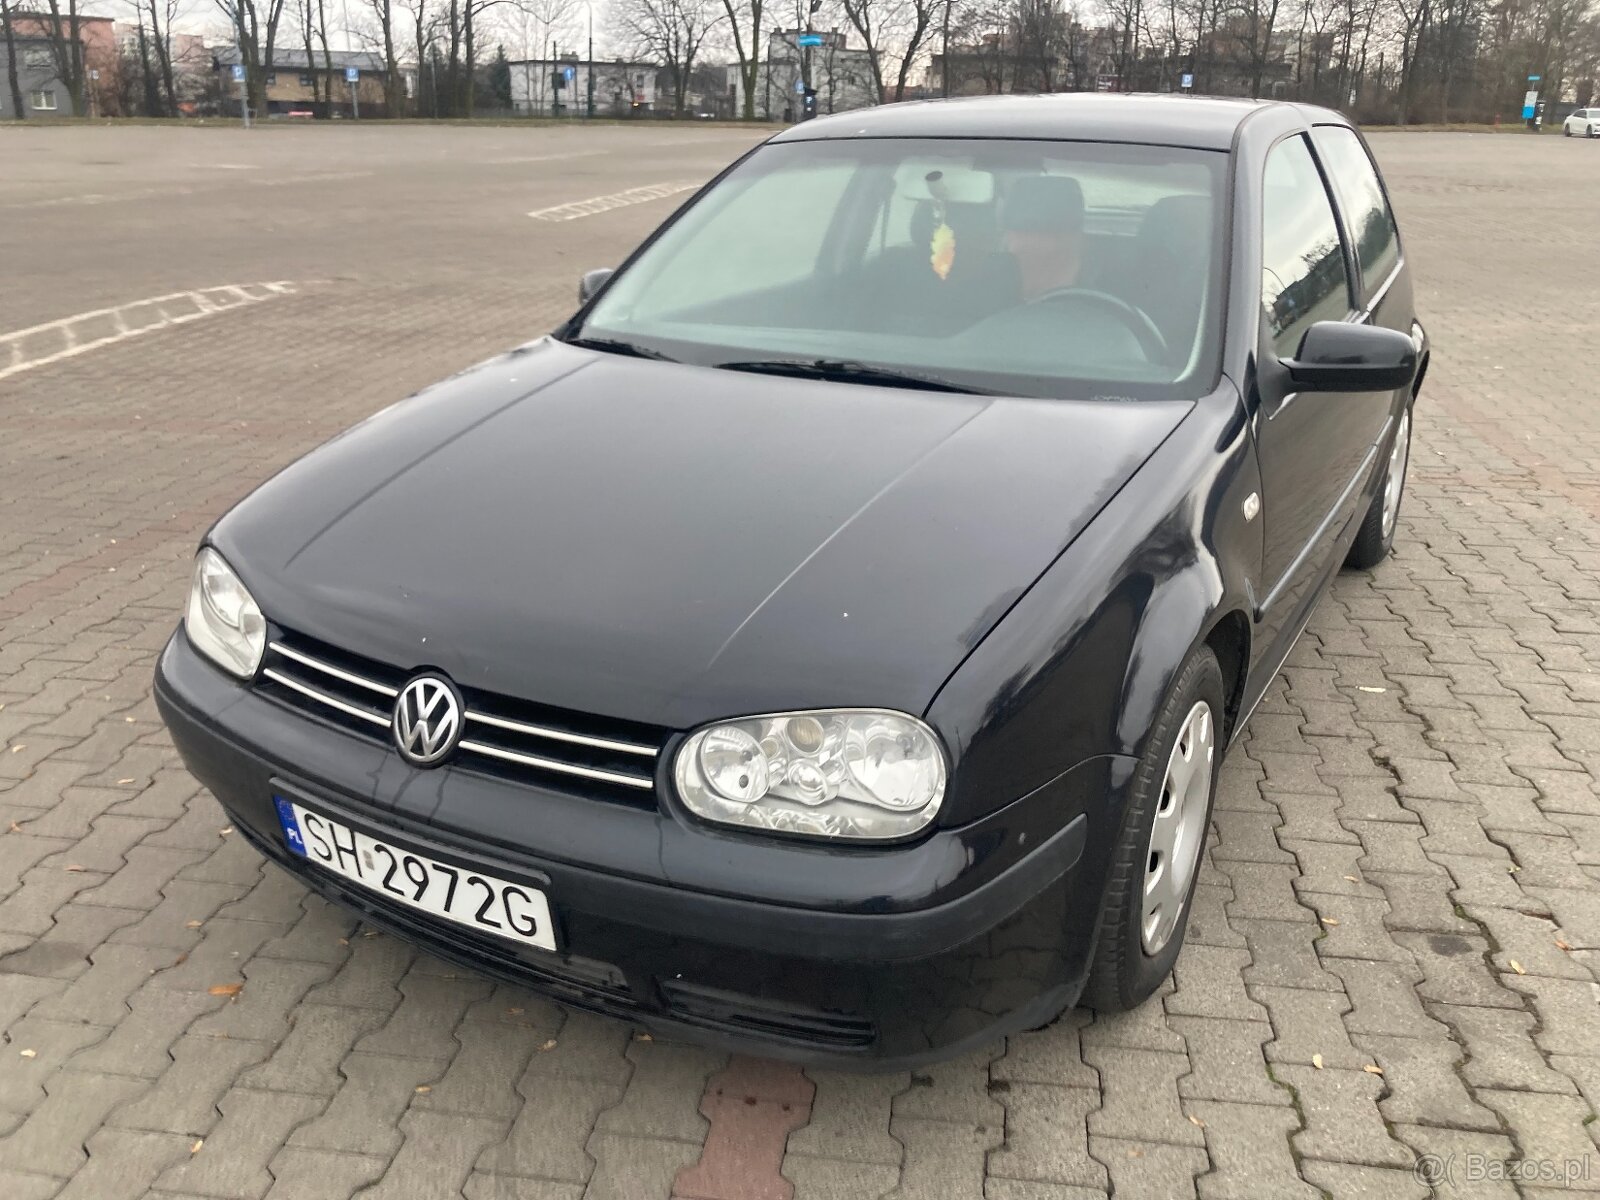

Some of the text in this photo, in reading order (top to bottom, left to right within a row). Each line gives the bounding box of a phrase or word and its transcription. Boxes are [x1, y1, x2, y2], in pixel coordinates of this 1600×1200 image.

[286, 827, 303, 845] PL
[303, 813, 538, 937] SH 2972G
